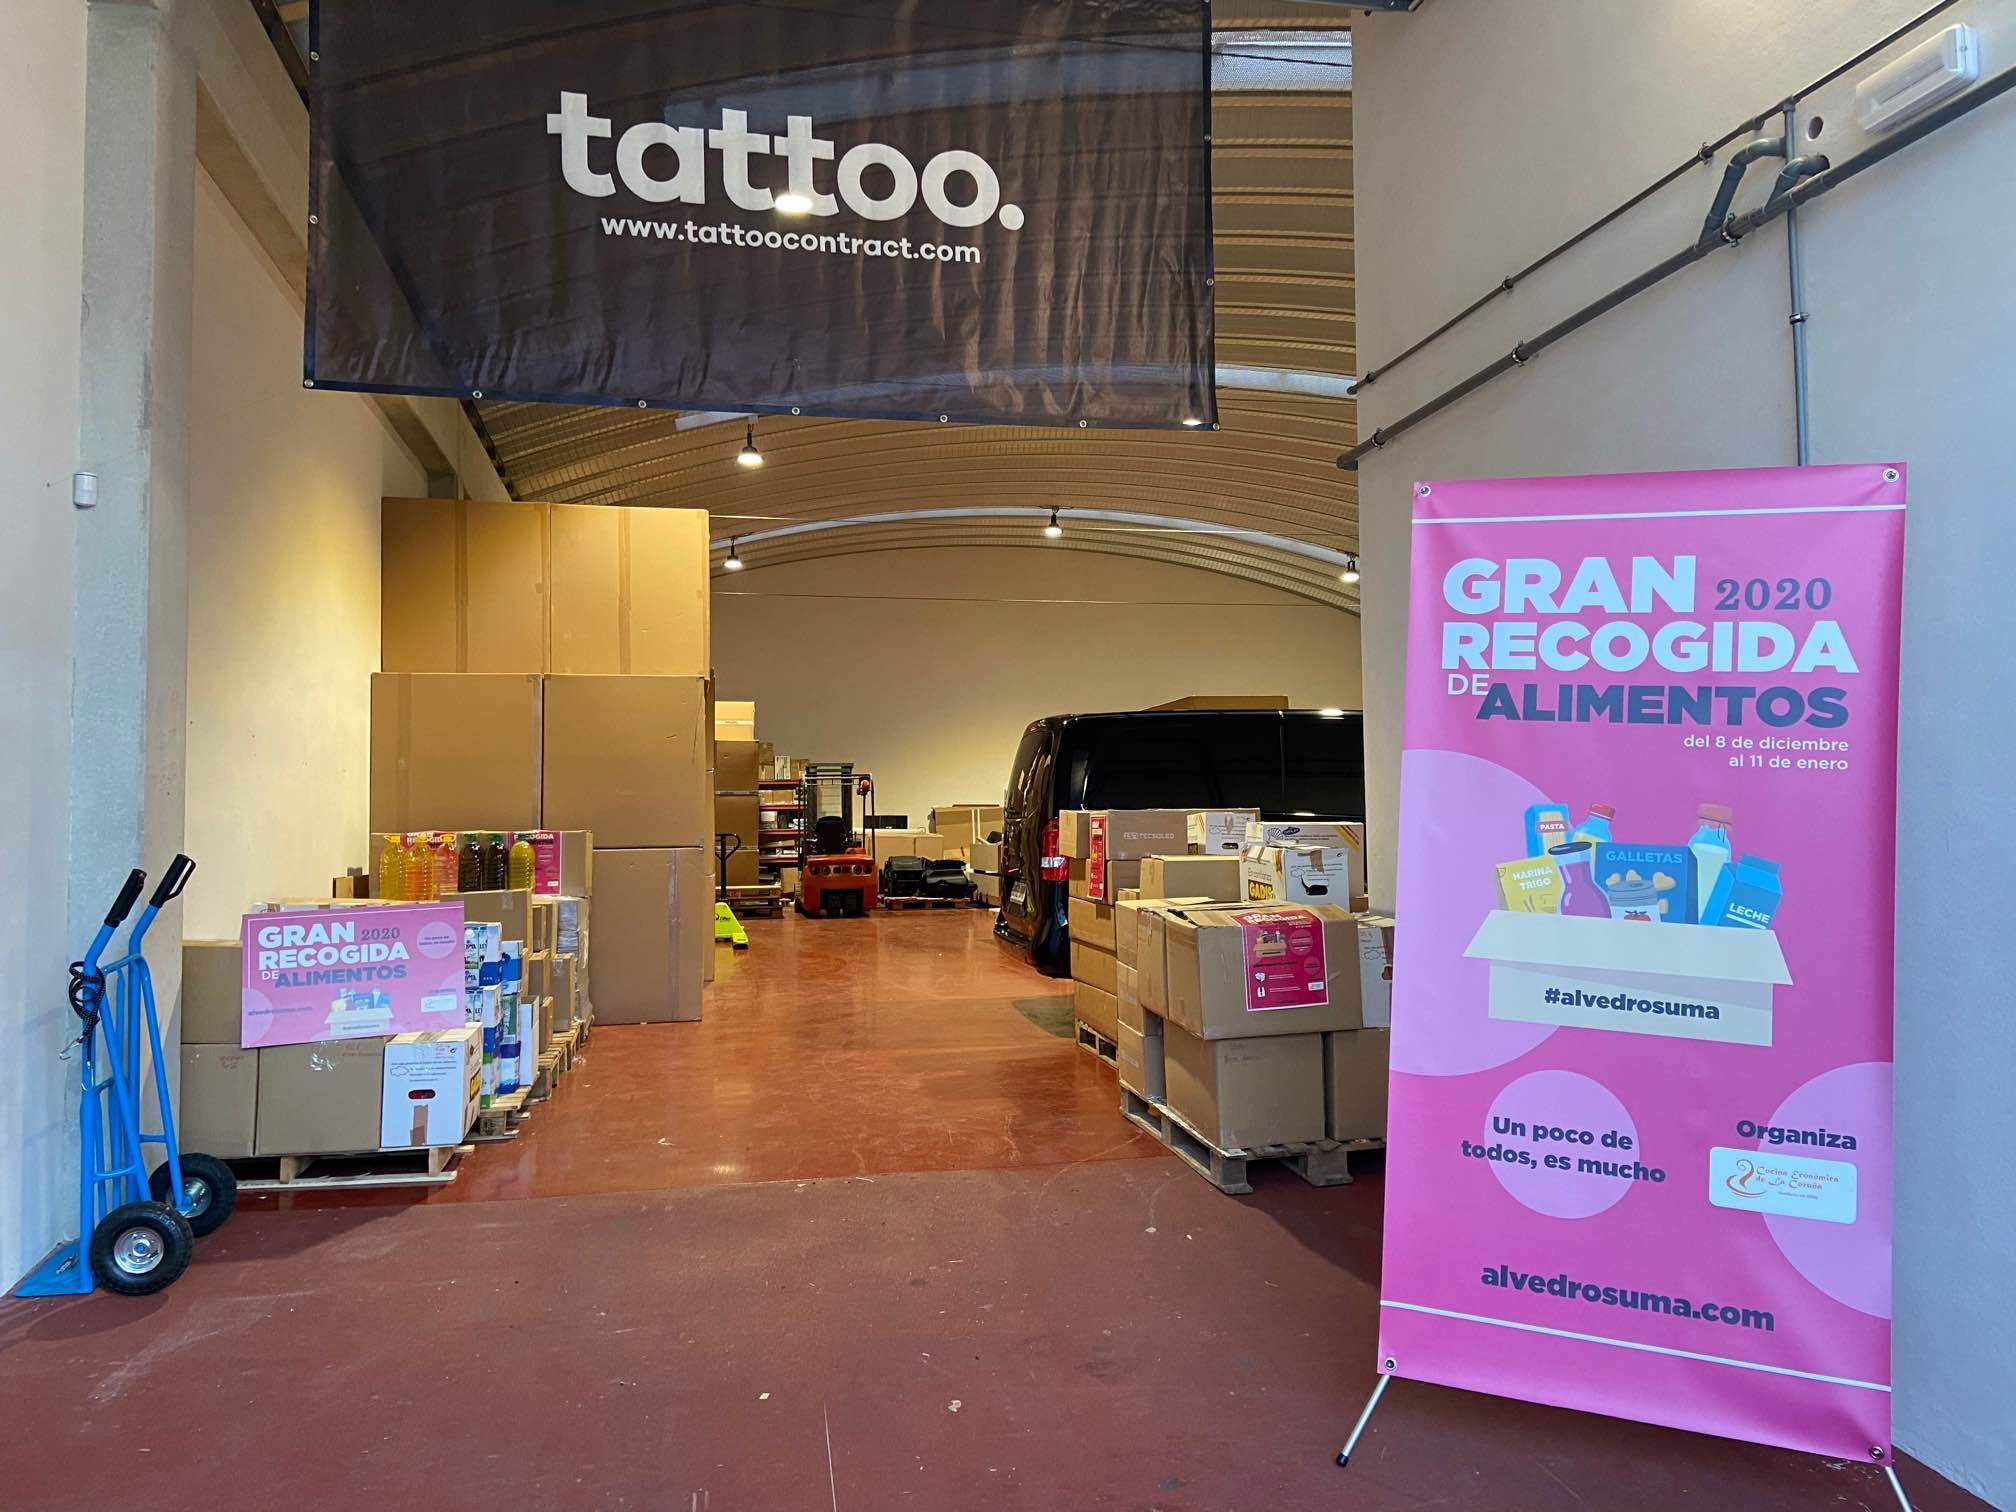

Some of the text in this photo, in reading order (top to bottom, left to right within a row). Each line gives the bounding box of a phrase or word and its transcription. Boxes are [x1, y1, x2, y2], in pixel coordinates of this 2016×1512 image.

[547, 91, 1025, 231] tattoo.
[601, 216, 982, 264] www.tattoocontract.com
[1442, 555, 1832, 615] GRAN 2020
[1442, 621, 1860, 673] RECOGIDA
[1447, 673, 1849, 729] DE ALIMENTOS
[1683, 734, 1849, 752] del 8 de diciembre
[1728, 754, 1849, 771] al 11 de enero
[1540, 823, 1565, 831] PASTA
[1605, 849, 1684, 865] GALLETAS
[1512, 866, 1553, 881] HARINA
[1519, 877, 1552, 891] TRIGO
[1728, 902, 1771, 924] LECHE
[257, 921, 401, 949] GRAN 2020
[258, 941, 411, 971] RECOGIDA
[261, 964, 408, 989] DE ALIMENTOS
[1543, 986, 1721, 1020] #alvedrosuma
[1492, 1115, 1634, 1151] Un poco de
[1736, 1119, 1858, 1151] Organiza
[1460, 1139, 1667, 1184] todos, es mucho
[1480, 1264, 1776, 1332] alvedrosuma.com
